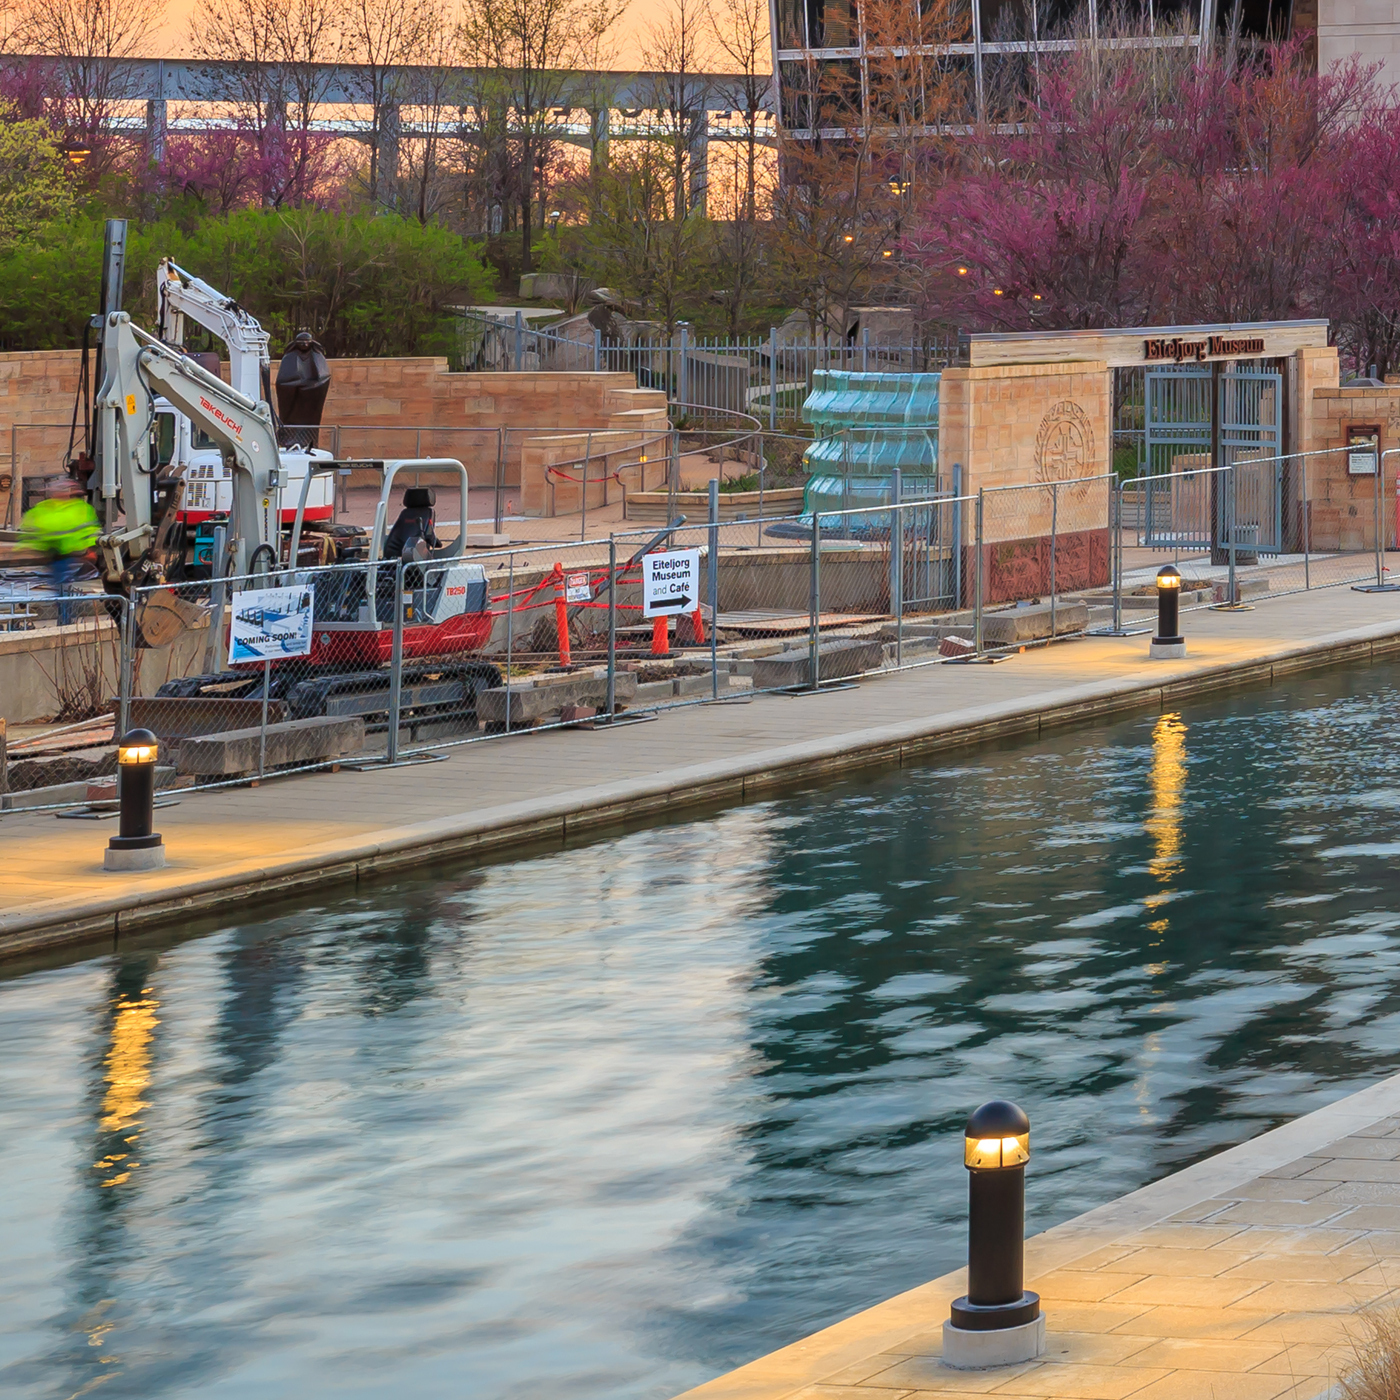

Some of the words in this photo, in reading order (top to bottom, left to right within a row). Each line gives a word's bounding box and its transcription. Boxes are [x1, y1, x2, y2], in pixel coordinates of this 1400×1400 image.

[1144, 338, 1207, 361] Eiteljorg
[1208, 336, 1265, 355] Museum
[652, 559, 690, 570] Eiteljorg
[652, 570, 691, 582] Museum
[446, 586, 465, 596] TB250
[653, 587, 667, 595] and
[670, 582, 690, 593] Café
[237, 635, 269, 646] COMING
[272, 632, 297, 641] SOON!
